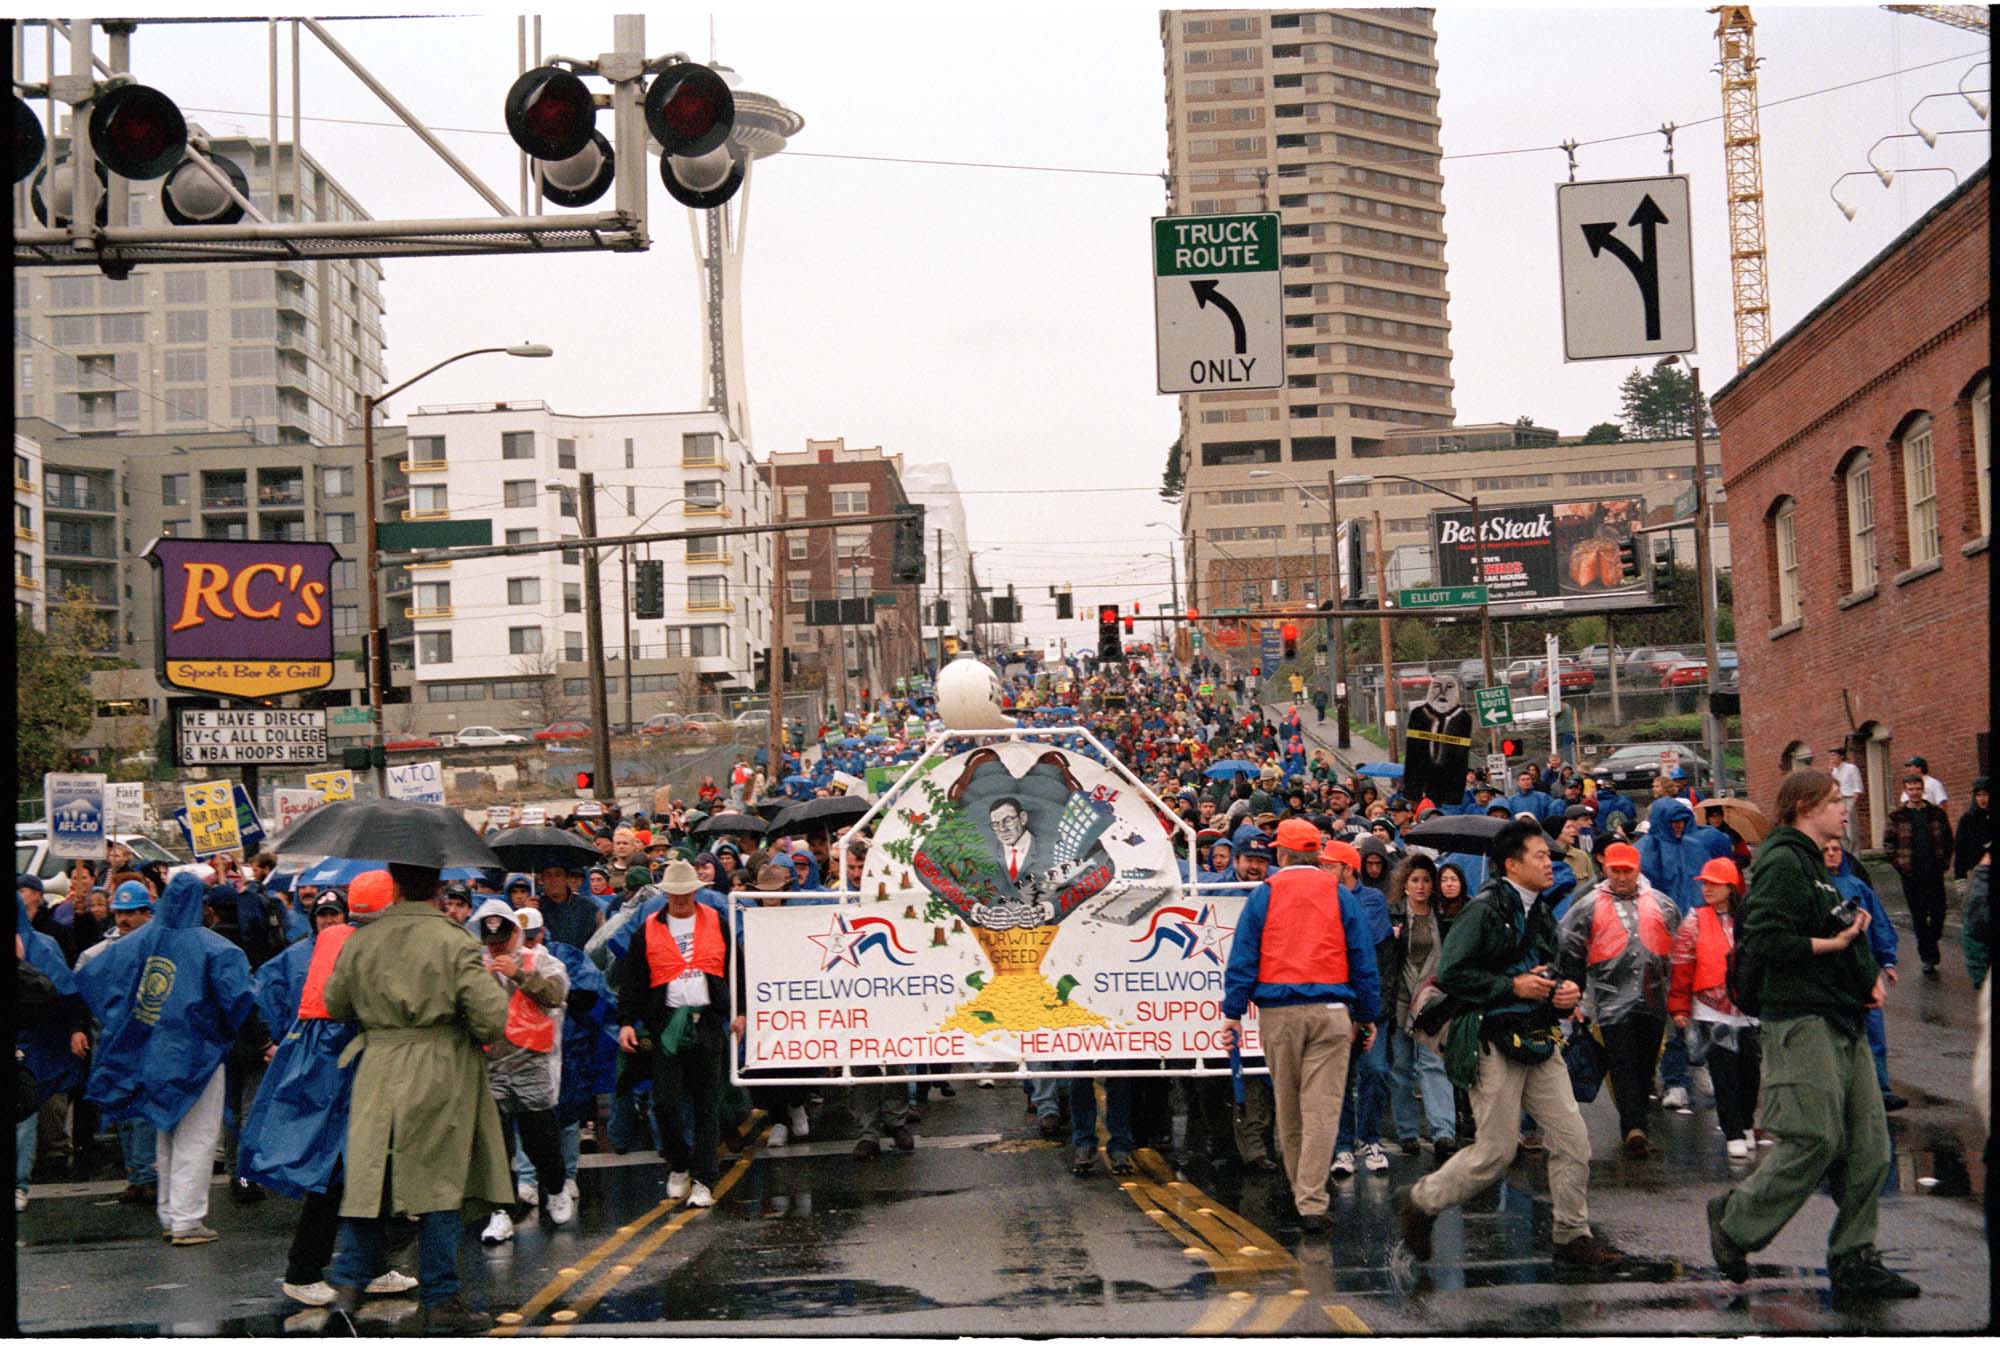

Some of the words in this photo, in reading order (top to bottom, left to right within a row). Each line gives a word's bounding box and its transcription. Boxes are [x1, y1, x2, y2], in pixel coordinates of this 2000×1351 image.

[1174, 222, 1259, 245] TRUCK
[1175, 245, 1260, 269] ROUTE
[1190, 358, 1256, 384] ONLY
[1489, 513, 1552, 541] Steak
[171, 561, 325, 632] RC's
[1411, 591, 1451, 603] ELLIOTT
[178, 664, 228, 682] Sports
[233, 665, 262, 679] Bar
[266, 665, 281, 677] &
[287, 664, 321, 679] Grill
[1480, 689, 1505, 699] TRUCK
[1481, 698, 1507, 709] ROUTE
[185, 713, 205, 726] WE
[217, 713, 255, 726] HAVE
[264, 712, 315, 726] DIRECT
[184, 730, 220, 743] TV-C
[231, 729, 258, 742] ALL
[265, 729, 327, 742] COLLEGE
[185, 747, 194, 761] &
[200, 747, 228, 760] NBA
[235, 746, 284, 760] HOOPS
[289, 746, 325, 759] HERE
[116, 787, 140, 798] Fair
[58, 821, 98, 832] AFL-CIO
[1058, 864, 1112, 912] KAISER
[978, 931, 1053, 948] HURWITZ
[991, 949, 1039, 965] GREED
[756, 974, 954, 1002] STEELWORKERS
[1094, 971, 1224, 993] STEELWOR
[757, 1010, 806, 1031] FOR
[818, 1008, 869, 1030] FAIR
[757, 1039, 838, 1060] LABOR
[850, 1036, 965, 1059] PRACTICE
[1020, 1031, 1172, 1053] HEADWATERS
